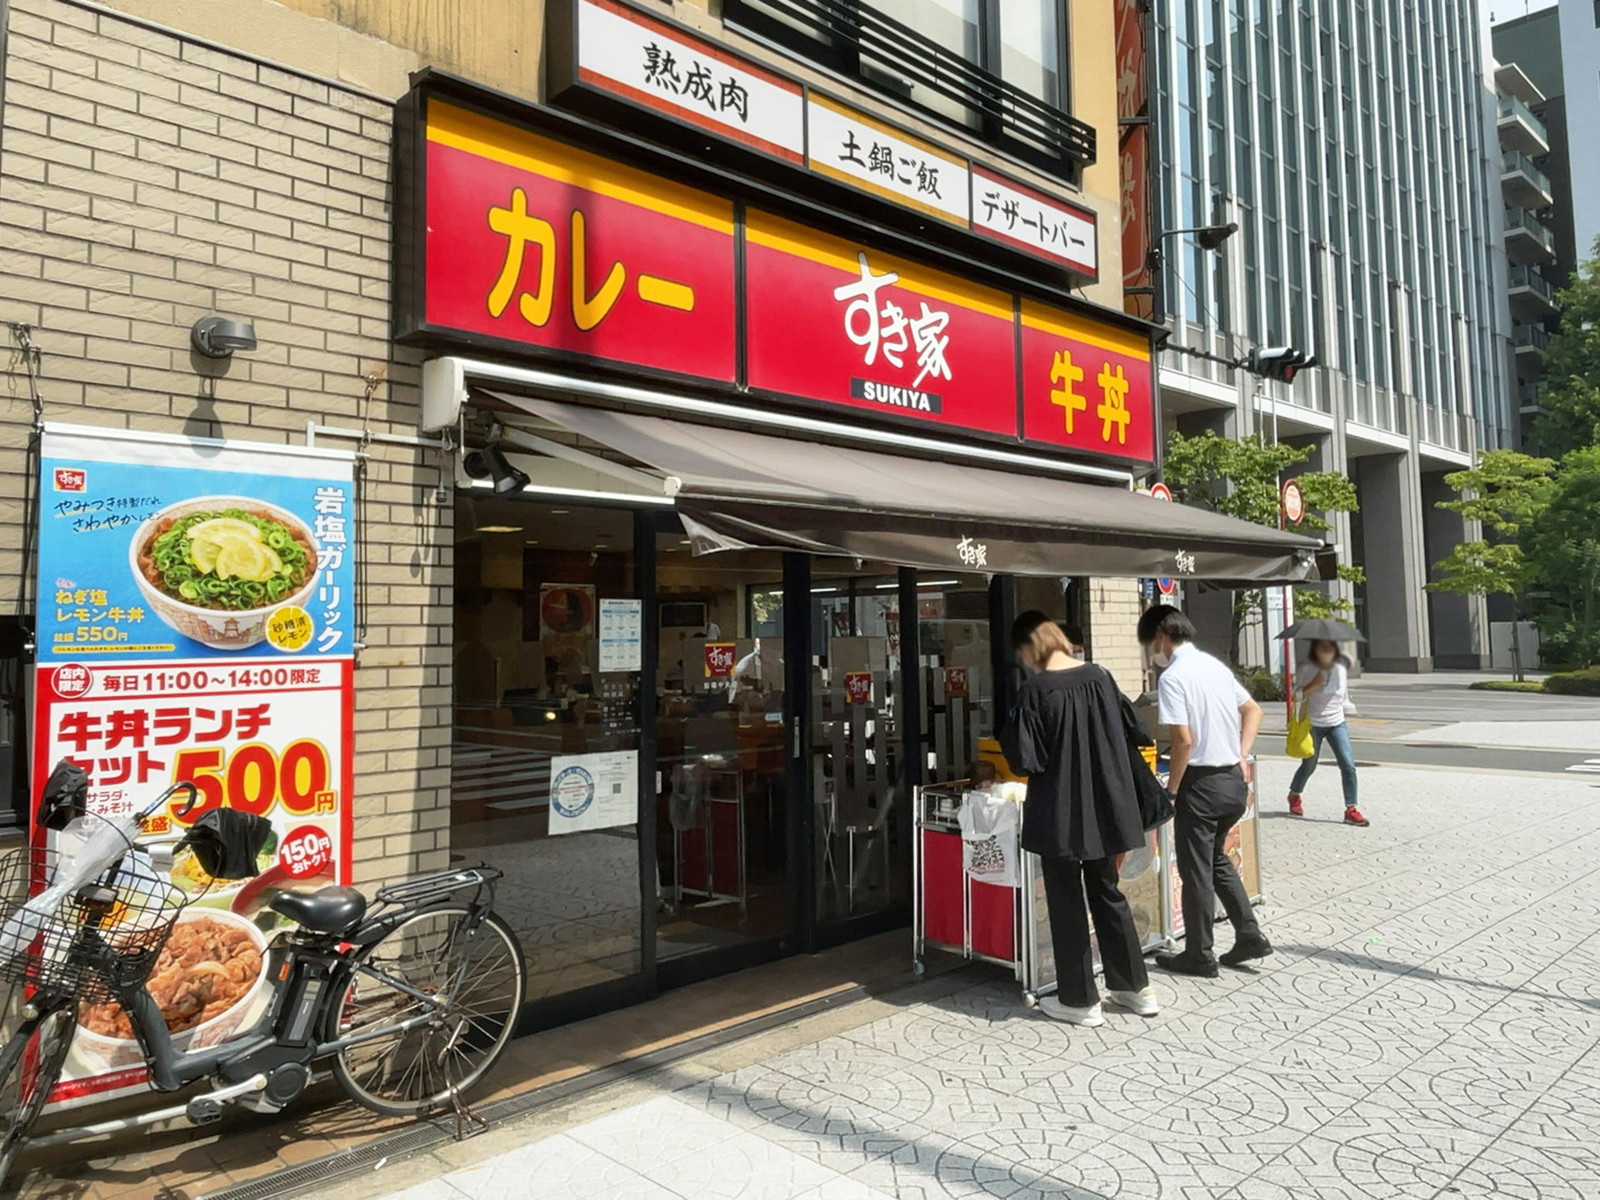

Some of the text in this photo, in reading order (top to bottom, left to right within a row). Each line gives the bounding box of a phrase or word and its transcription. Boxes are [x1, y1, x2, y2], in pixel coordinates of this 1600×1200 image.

[642, 41, 749, 122] 熟成肉
[838, 130, 942, 201] 土鍋ご飯
[981, 191, 1086, 251] デザートバー
[485, 186, 695, 331] カレー
[834, 252, 953, 388] すき家
[862, 382, 931, 412] SUKIYA
[1049, 350, 1131, 445] 牛丼
[313, 486, 347, 654] 岩塩ガーリック
[957, 535, 987, 568] すき家
[55, 589, 108, 606] ねぎ塩
[56, 606, 145, 624] レモン牛丼
[278, 629, 308, 643] レモン
[58, 679, 86, 692] 限定
[59, 667, 85, 680] 店内
[58, 703, 271, 752] 牛丼ランチ
[281, 833, 331, 865] 150円
